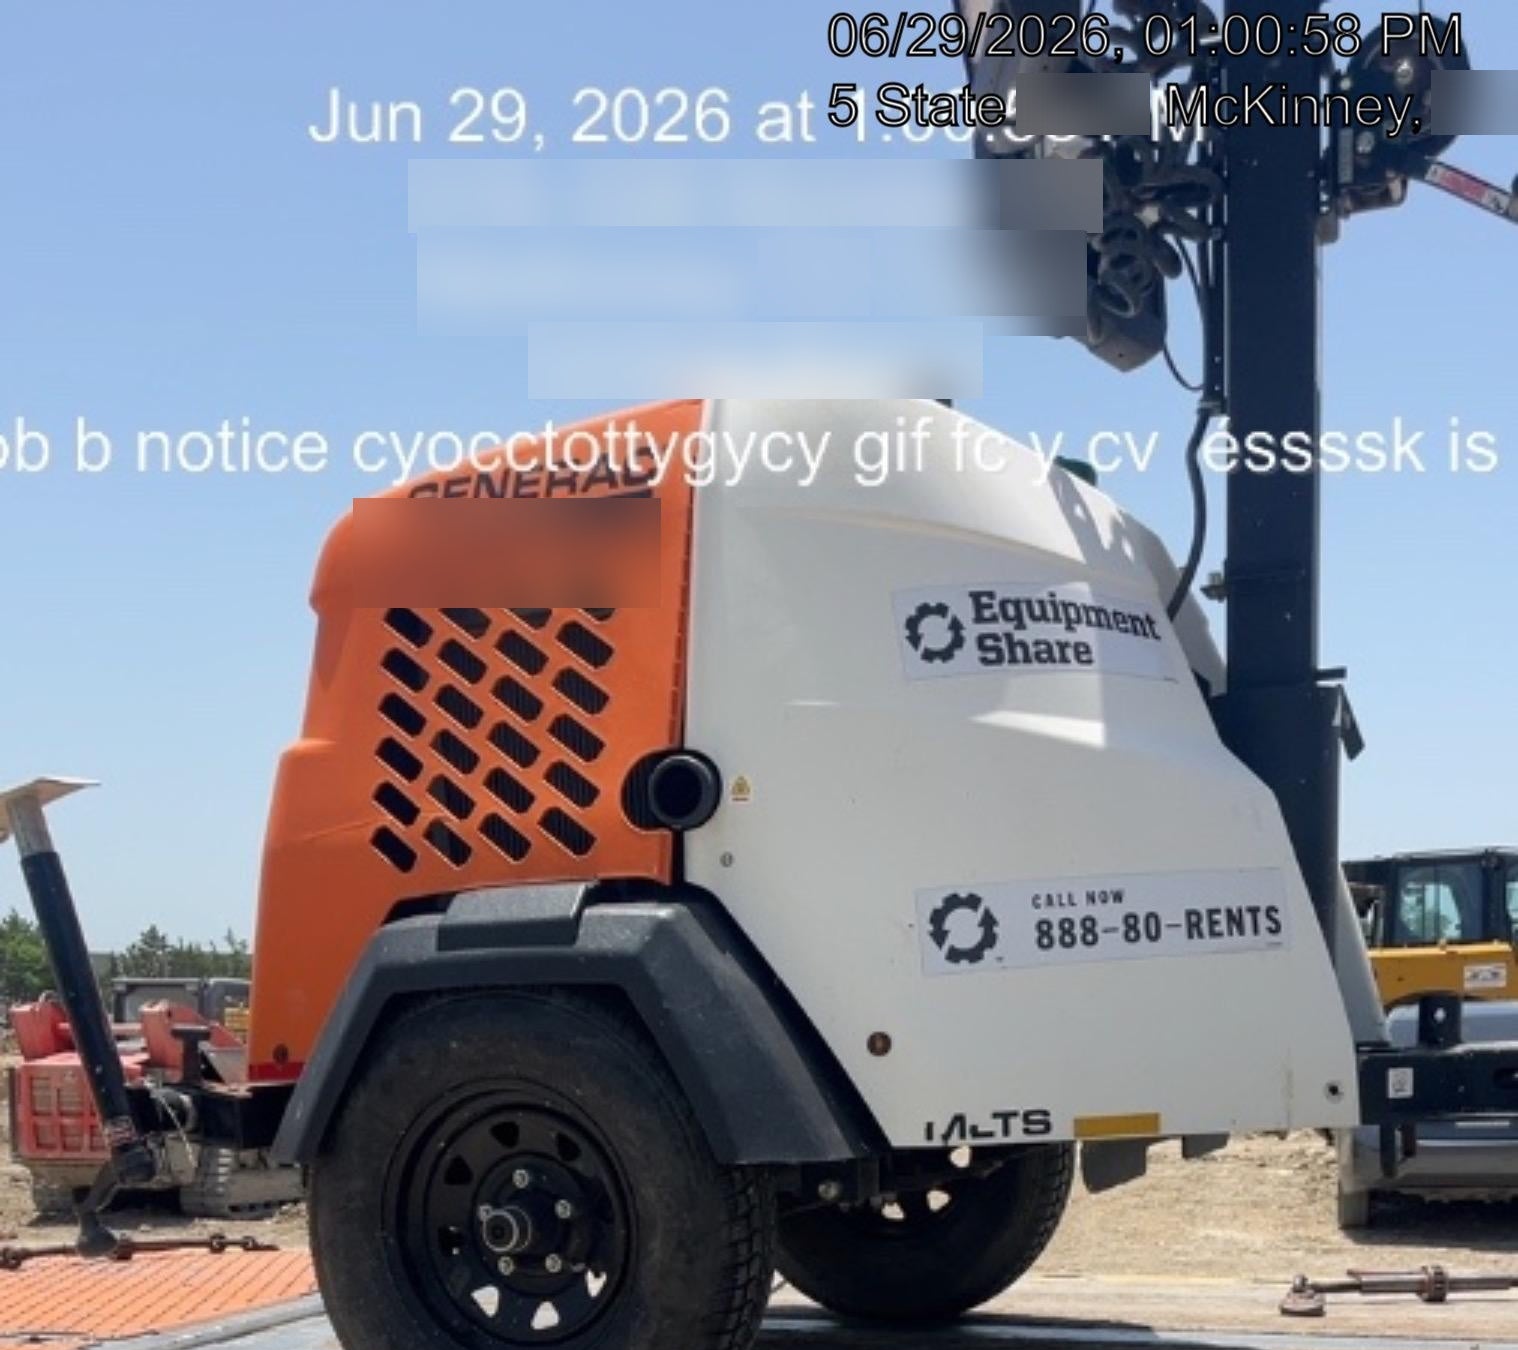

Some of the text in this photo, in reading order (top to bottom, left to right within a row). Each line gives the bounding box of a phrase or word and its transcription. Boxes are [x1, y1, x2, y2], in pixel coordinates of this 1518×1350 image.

[968, 590, 1162, 641] Equipment
[976, 631, 1094, 666] Share
[1031, 888, 1125, 909] CALL NOW
[1034, 904, 1283, 952] 888-80-RENTS
